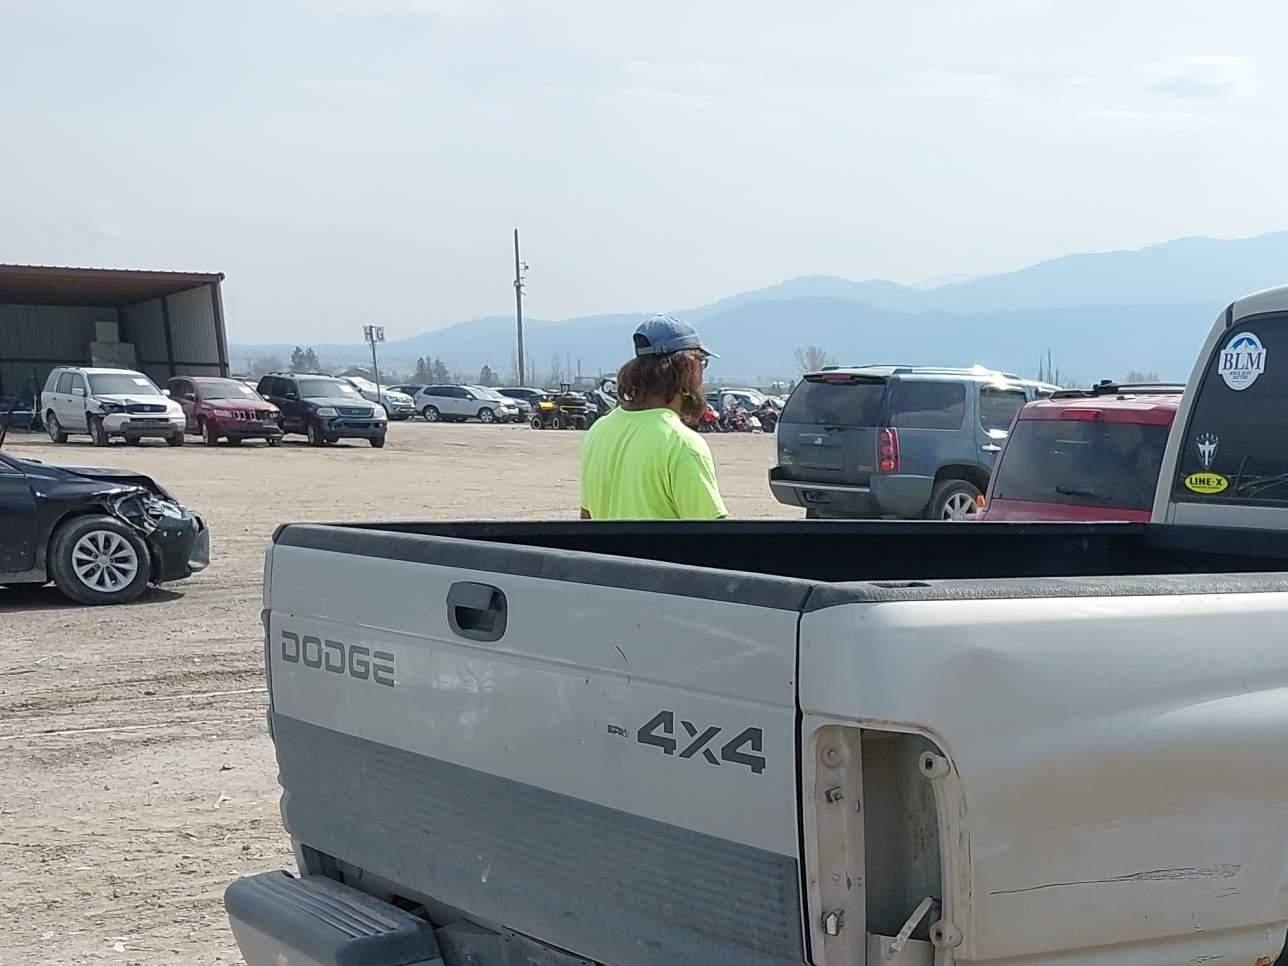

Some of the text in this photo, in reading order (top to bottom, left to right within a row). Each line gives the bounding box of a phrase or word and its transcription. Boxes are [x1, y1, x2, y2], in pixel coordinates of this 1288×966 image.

[376, 328, 384, 341] G
[1222, 352, 1262, 370] BLM
[1189, 477, 1222, 486] LINE-X
[281, 630, 395, 687] DODGE
